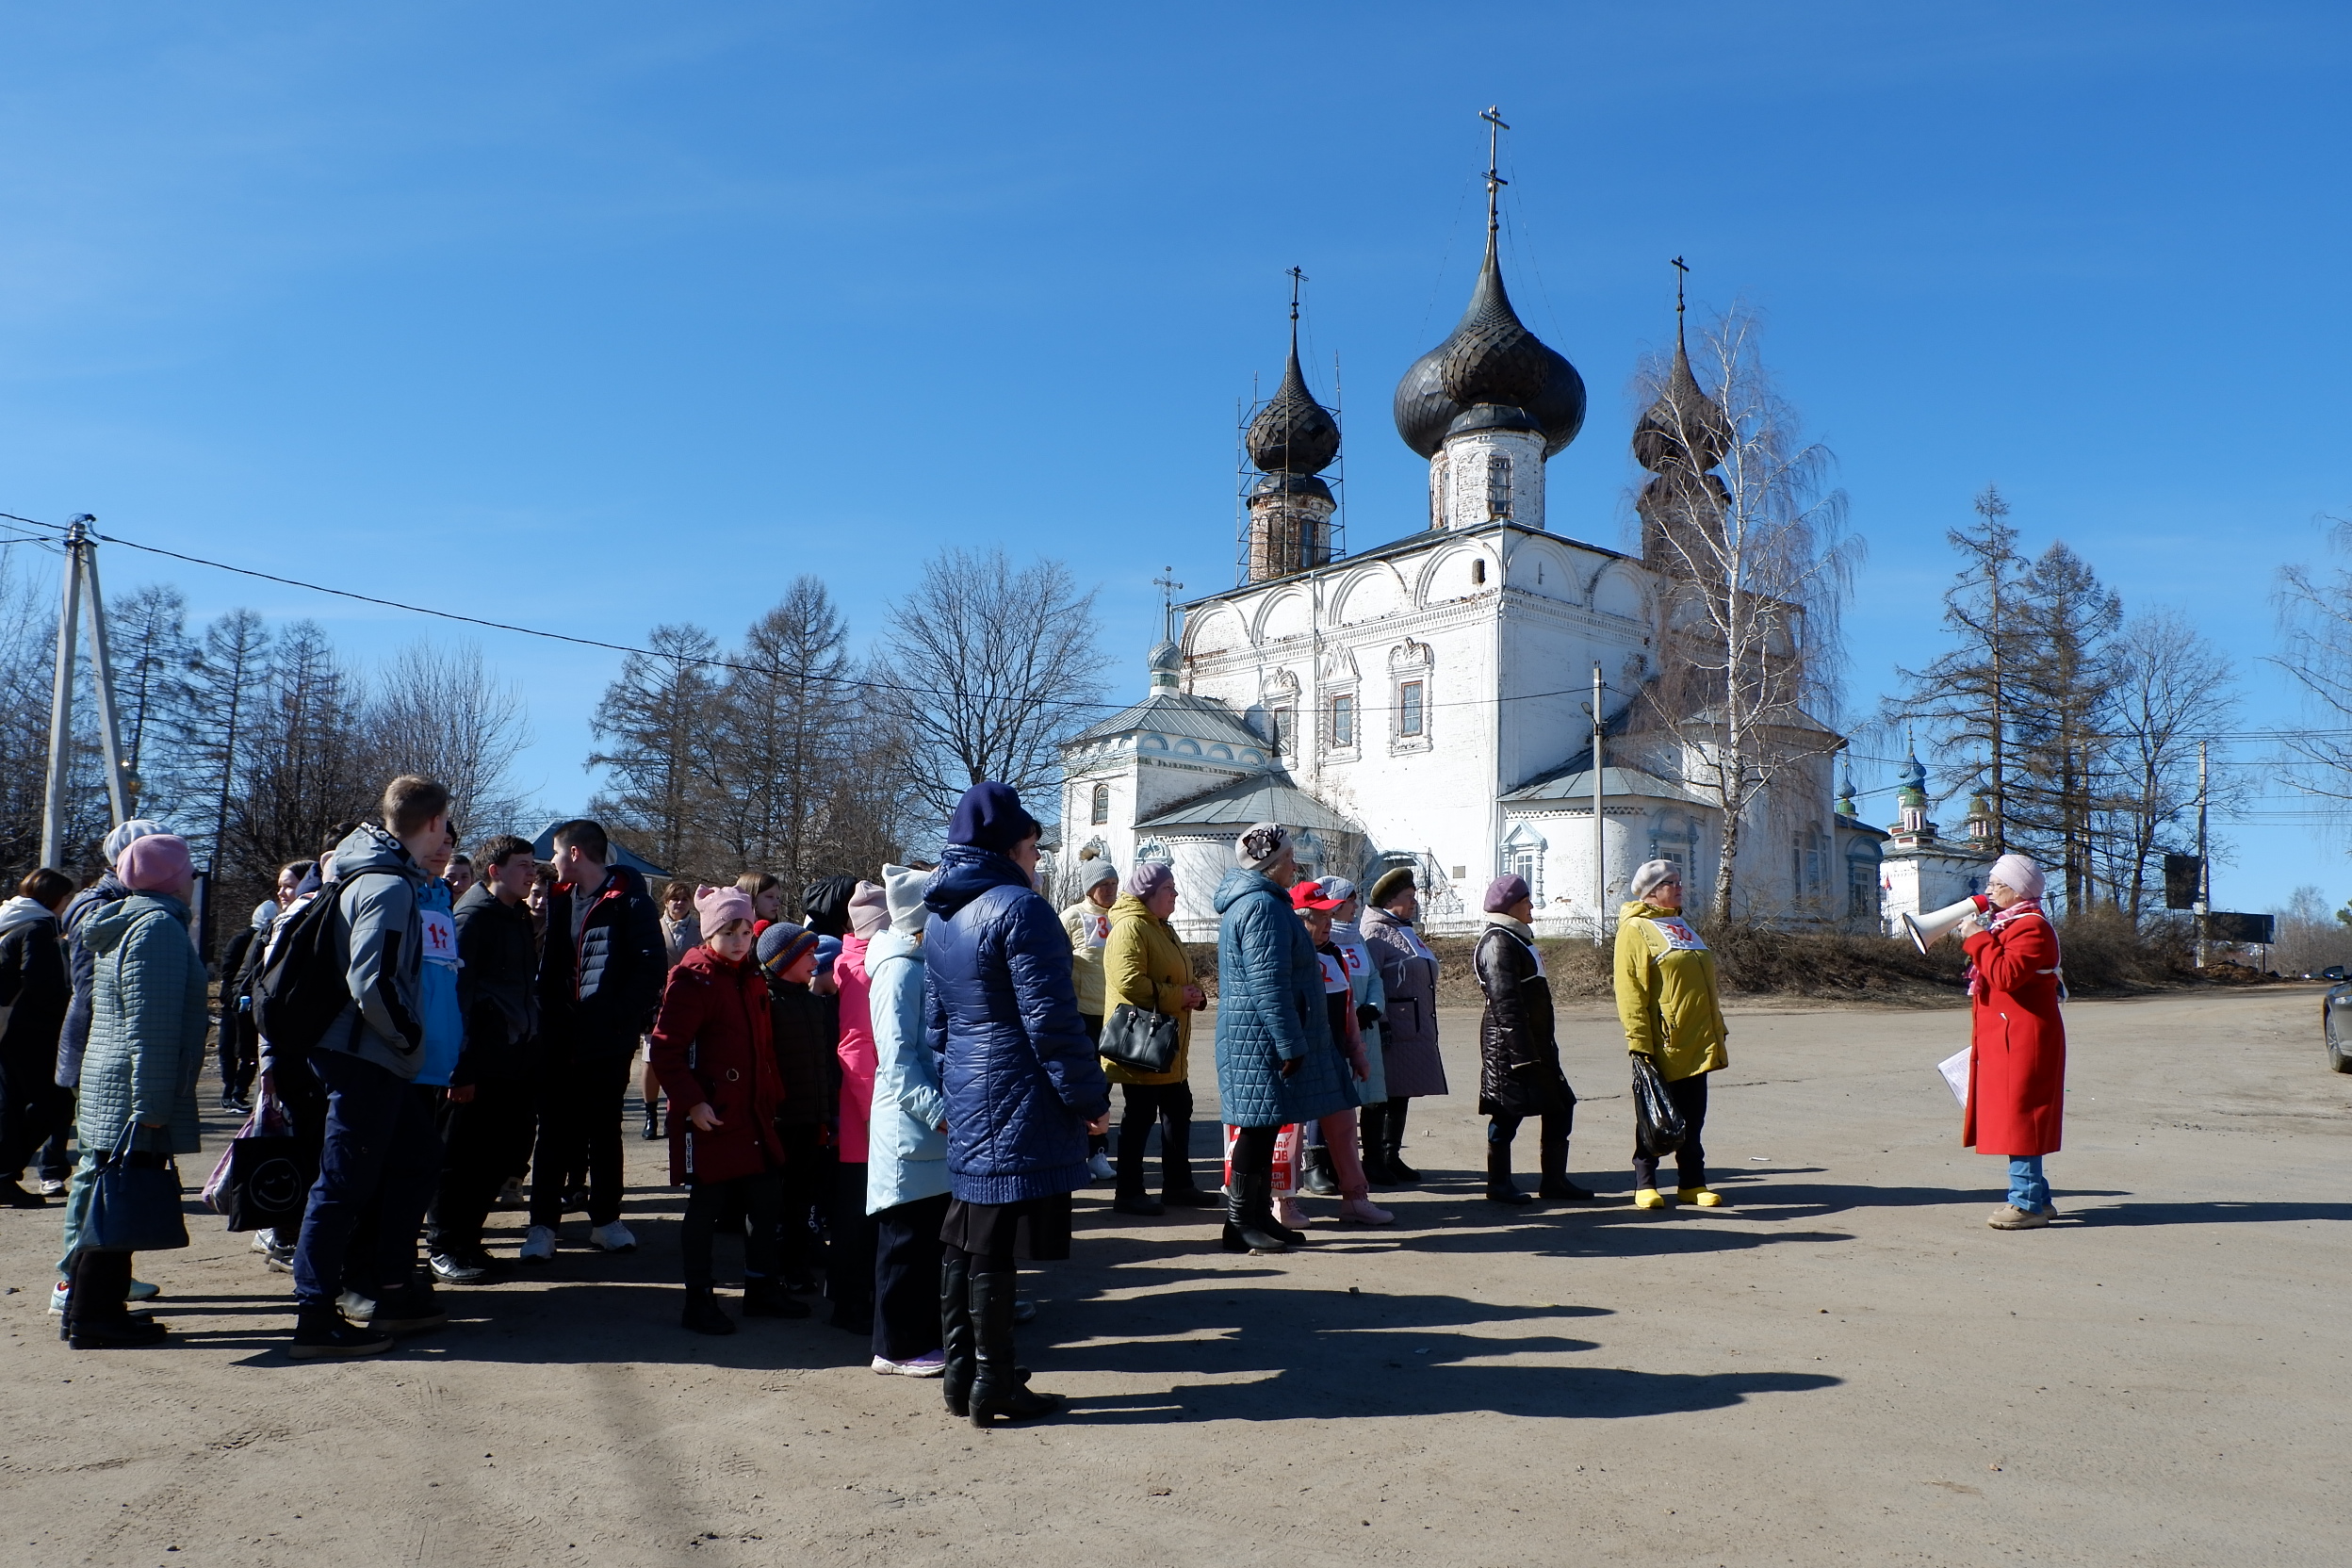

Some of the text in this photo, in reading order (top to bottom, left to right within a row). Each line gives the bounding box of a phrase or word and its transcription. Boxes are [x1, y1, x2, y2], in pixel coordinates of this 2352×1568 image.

[428, 923, 449, 950] 11
[1097, 916, 1109, 939] 3
[1666, 924, 1693, 941] 10
[1346, 948, 1361, 969] 5
[1319, 960, 1333, 982] 2
[1273, 1150, 1288, 1161] ОВ
